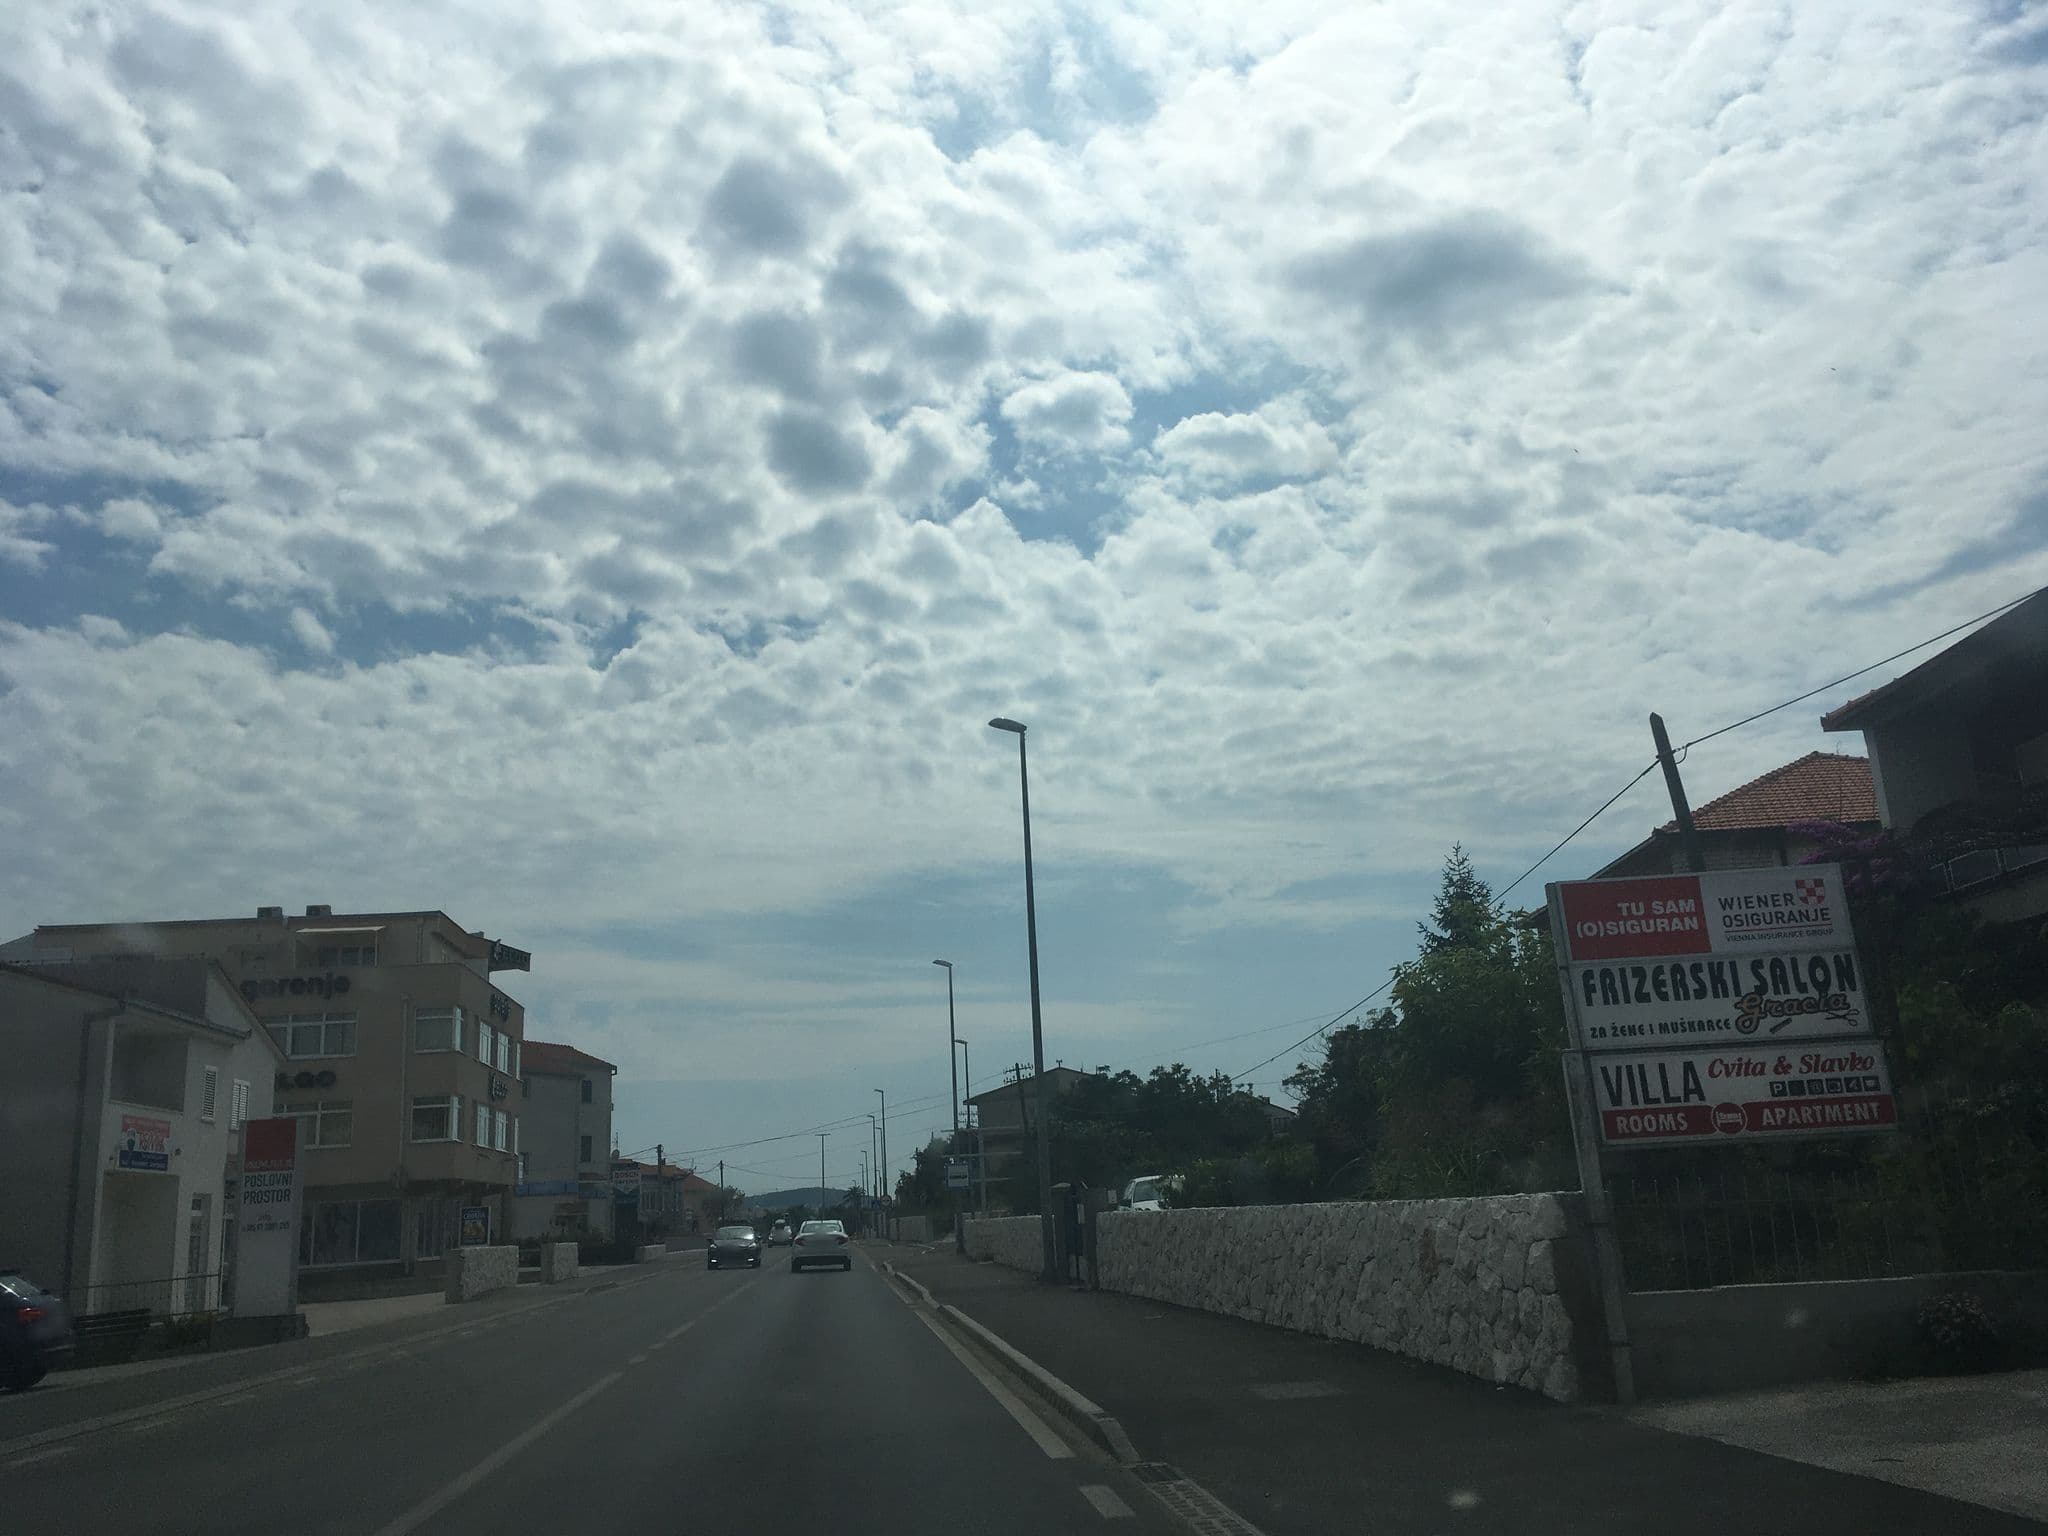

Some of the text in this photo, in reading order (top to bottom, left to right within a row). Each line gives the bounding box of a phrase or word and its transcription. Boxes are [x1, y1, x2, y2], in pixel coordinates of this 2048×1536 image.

[1617, 899, 1696, 917] TU SAM
[1718, 893, 1796, 911] WIENER
[1576, 917, 1699, 938] (O)SIGURAN
[1722, 907, 1832, 928] OSIGURANJE
[1582, 954, 1857, 1006] FRIZERSKI SALON
[1590, 1017, 1732, 1039] ZA ŽENE I MUŠKARCE
[1708, 1051, 1876, 1079] Cvita & Slavko
[1600, 1061, 1706, 1106] VILLA
[1616, 1112, 1689, 1134] ROOMS
[1762, 1101, 1881, 1126] APARTMENT
[244, 1173, 293, 1188] POSLOVNI
[243, 1188, 292, 1205] PROSTOR
